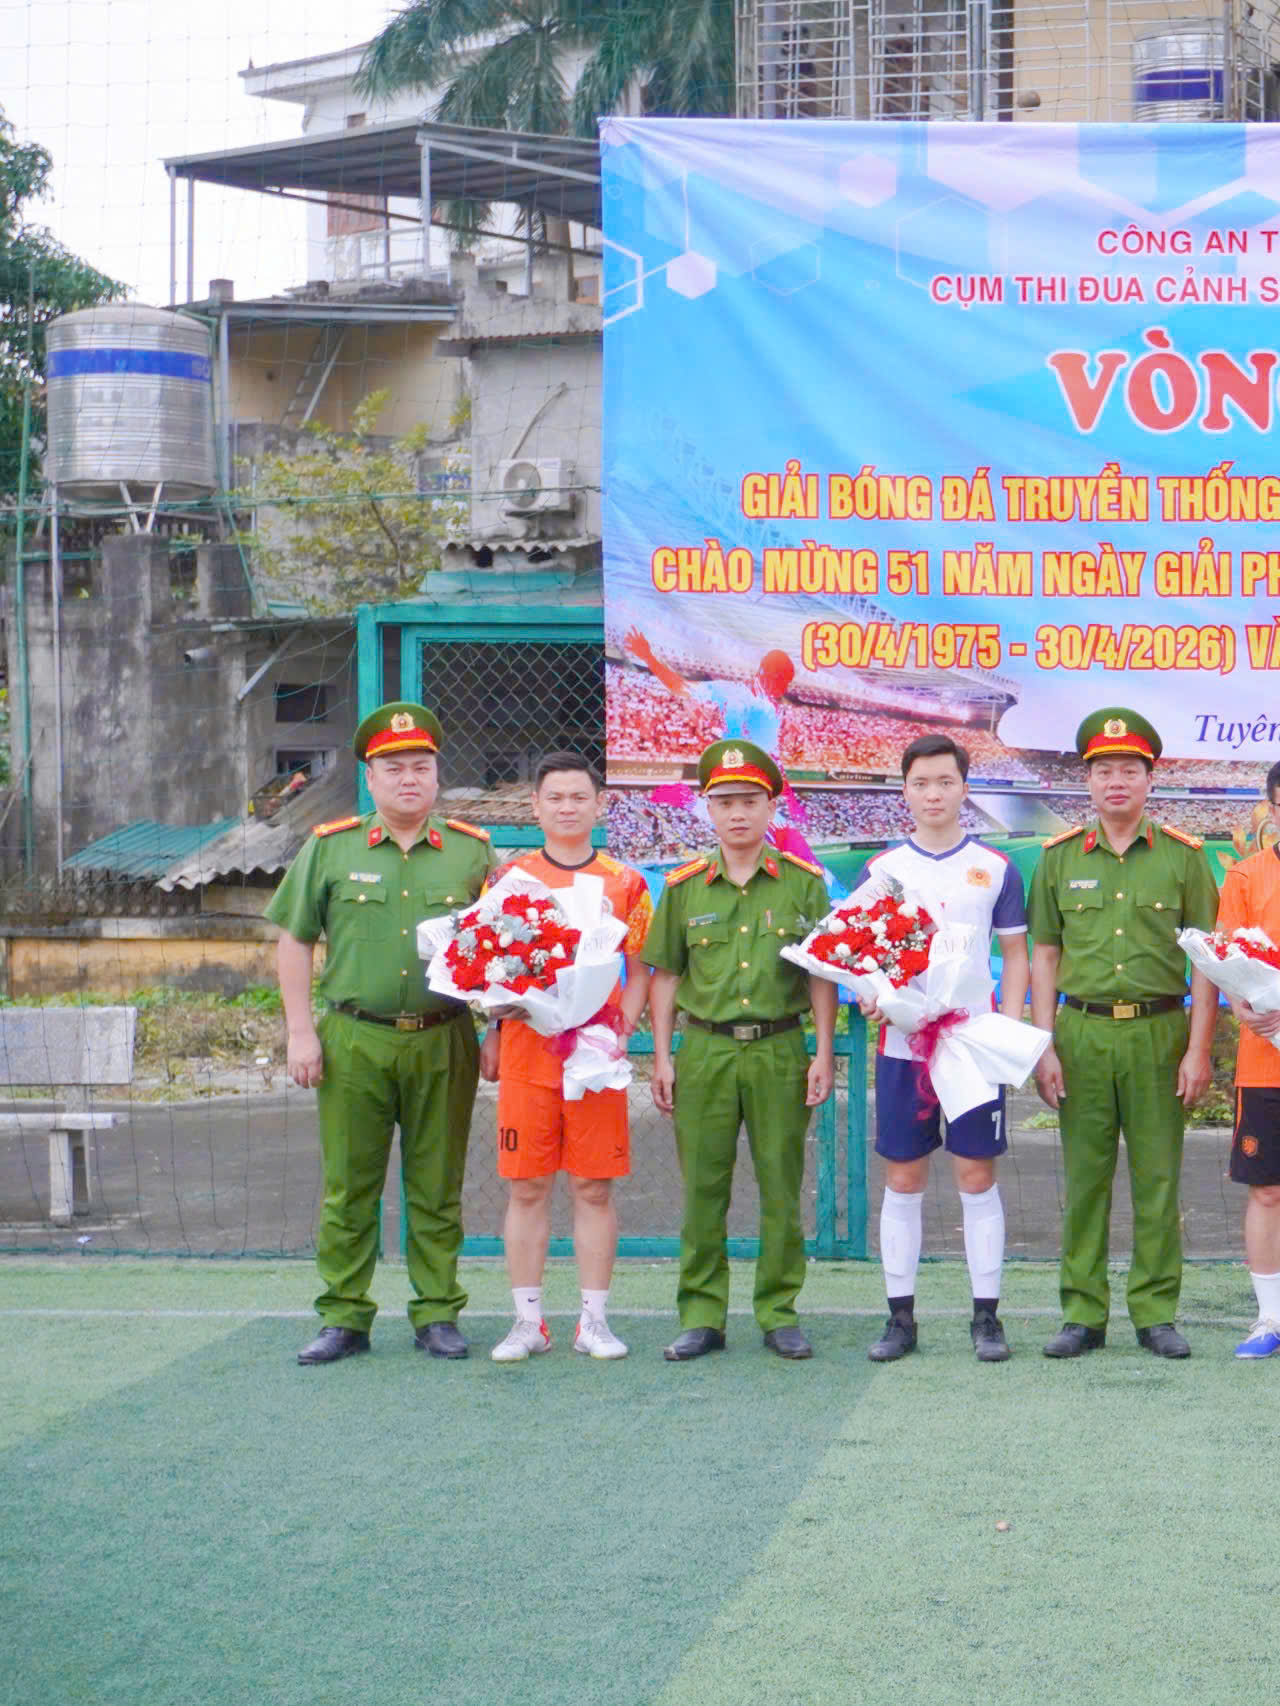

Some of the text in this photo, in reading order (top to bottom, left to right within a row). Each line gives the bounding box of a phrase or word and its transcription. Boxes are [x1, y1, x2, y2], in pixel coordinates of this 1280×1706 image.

[1098, 224, 1193, 256] CÔNG
[1206, 231, 1250, 256] AN
[931, 276, 1005, 307] CỤM
[1016, 277, 1069, 304] THI
[1078, 277, 1146, 304] ĐUA
[1156, 266, 1248, 304] CẢNH
[742, 459, 820, 520] GIẢI
[829, 467, 934, 521] BÓNG
[941, 467, 996, 521] ĐÁ
[1003, 460, 1150, 522] TRUYỀN
[652, 538, 754, 595] CHÀO
[763, 539, 880, 597] MỪNG
[888, 549, 930, 596] 51
[943, 542, 1034, 597] NĂM
[1044, 542, 1148, 597] NGÀY
[1155, 538, 1234, 598] GIẢI
[801, 622, 1002, 674] (30/4/1975
[1010, 642, 1028, 658] -
[1035, 624, 1238, 675] 30/4/2026)
[500, 1126, 518, 1152] 10
